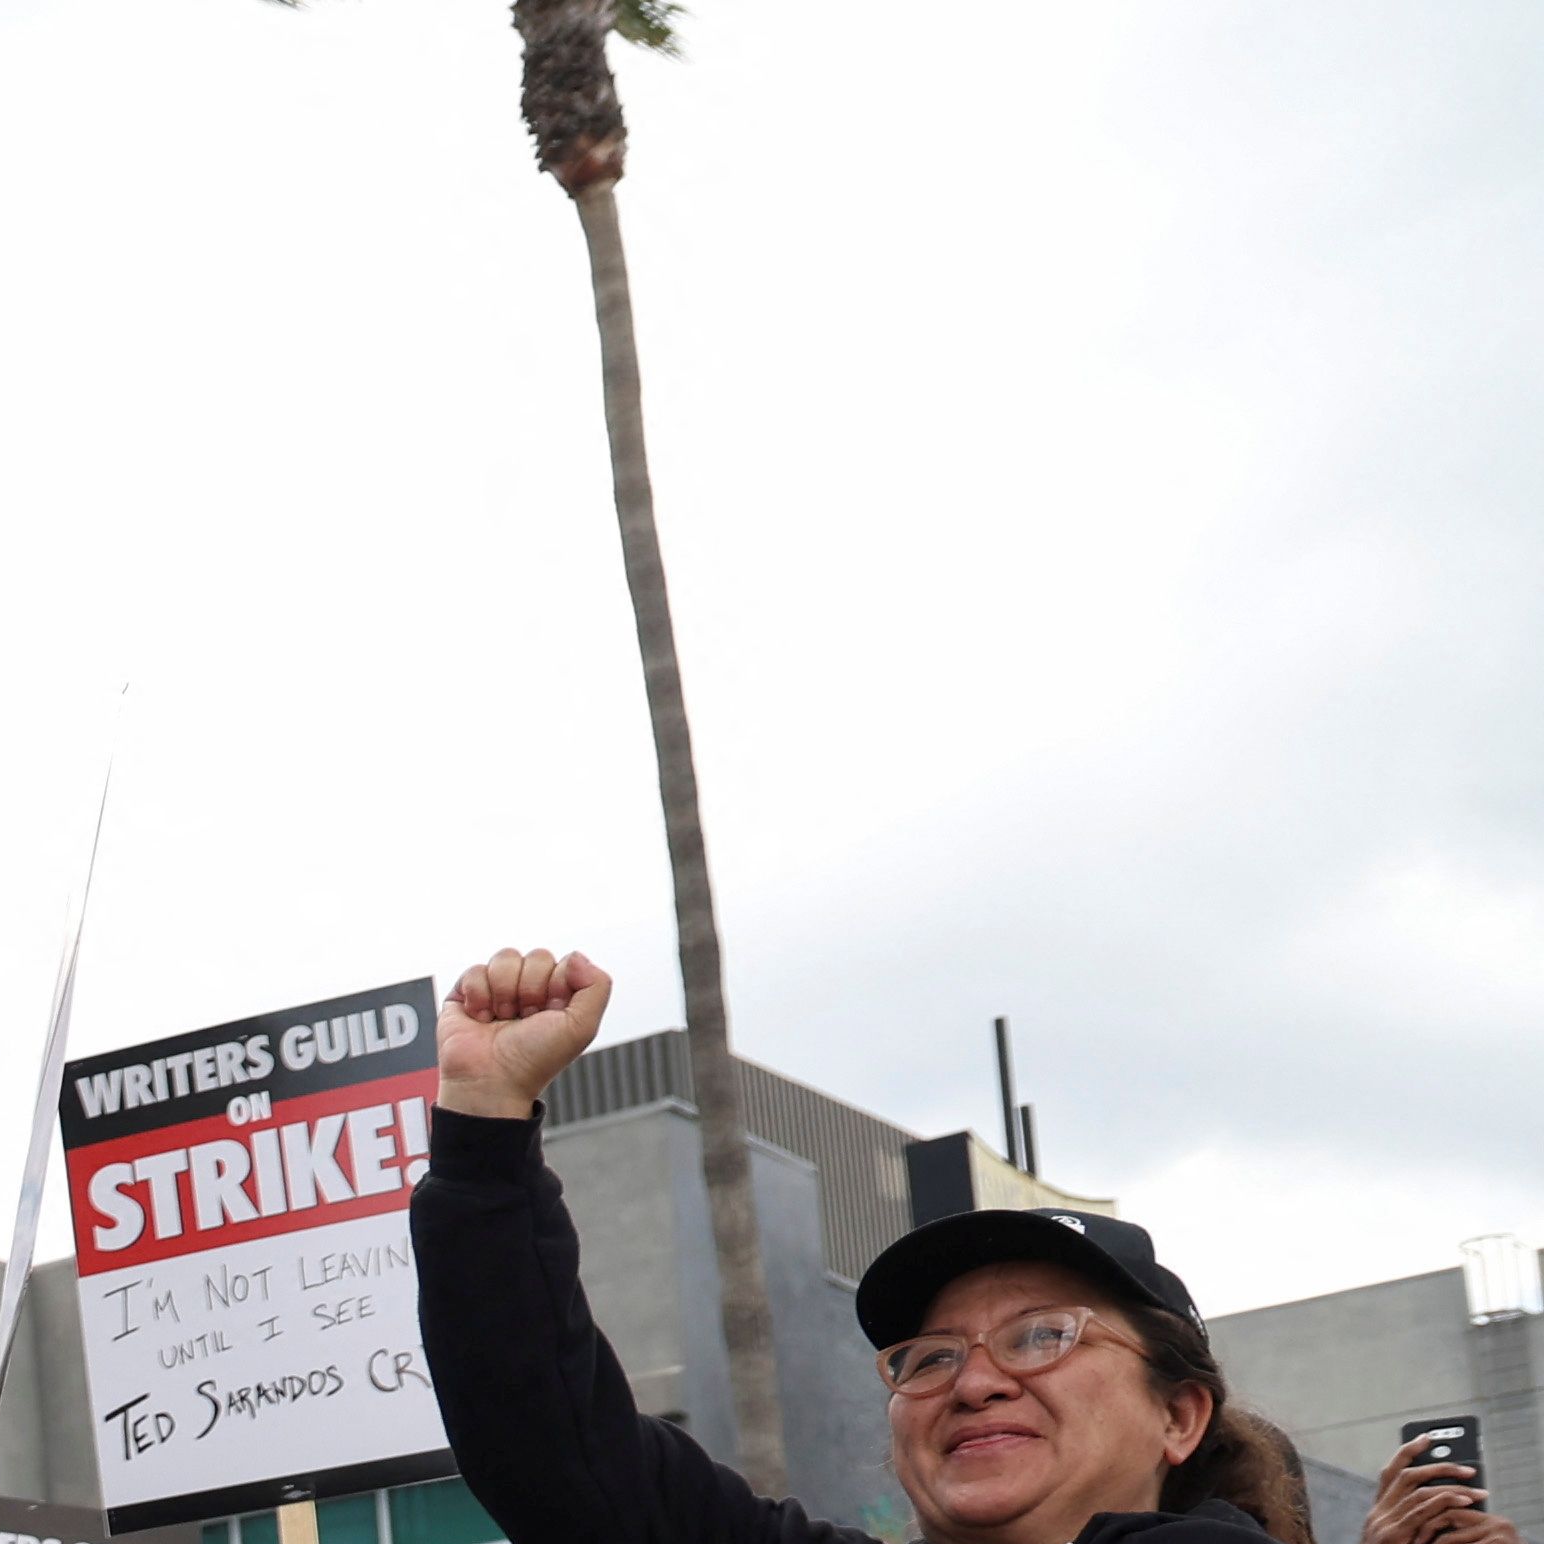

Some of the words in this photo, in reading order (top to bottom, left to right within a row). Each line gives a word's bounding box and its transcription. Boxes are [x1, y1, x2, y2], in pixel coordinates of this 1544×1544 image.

[75, 1034, 275, 1120] WRITERS
[280, 1002, 419, 1071] GUILD
[226, 1090, 272, 1128] ON
[88, 1096, 430, 1253] STRIKE!
[103, 1277, 180, 1342] I'M
[205, 1263, 273, 1311] NOT
[298, 1235, 412, 1291] LEAVIN
[159, 1330, 234, 1370] UNTIL
[258, 1316, 284, 1342] I
[312, 1295, 376, 1330] SEE
[368, 1348, 433, 1393] CR
